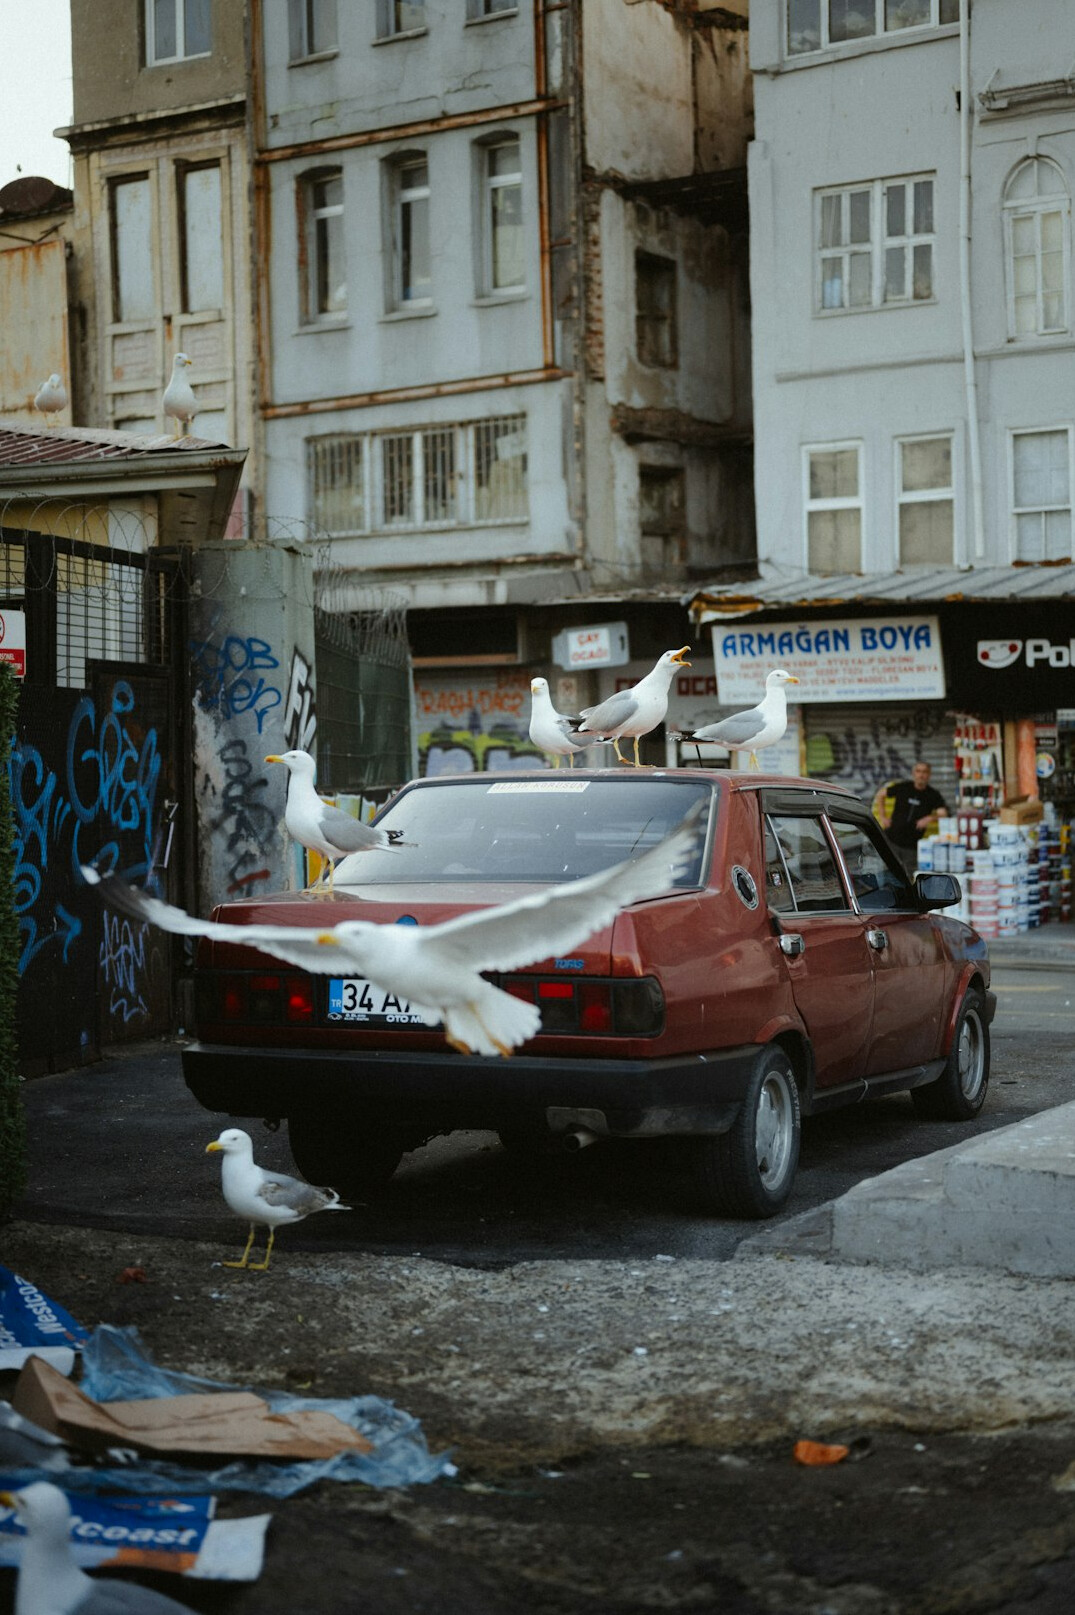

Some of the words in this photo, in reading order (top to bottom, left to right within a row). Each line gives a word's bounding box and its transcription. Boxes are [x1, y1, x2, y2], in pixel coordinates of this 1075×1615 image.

[722, 625, 850, 658] ARMAĞAN
[860, 624, 931, 651] BOYA
[331, 999, 342, 1008] TR
[343, 983, 374, 1012] 34
[386, 1014, 409, 1024] OTO
